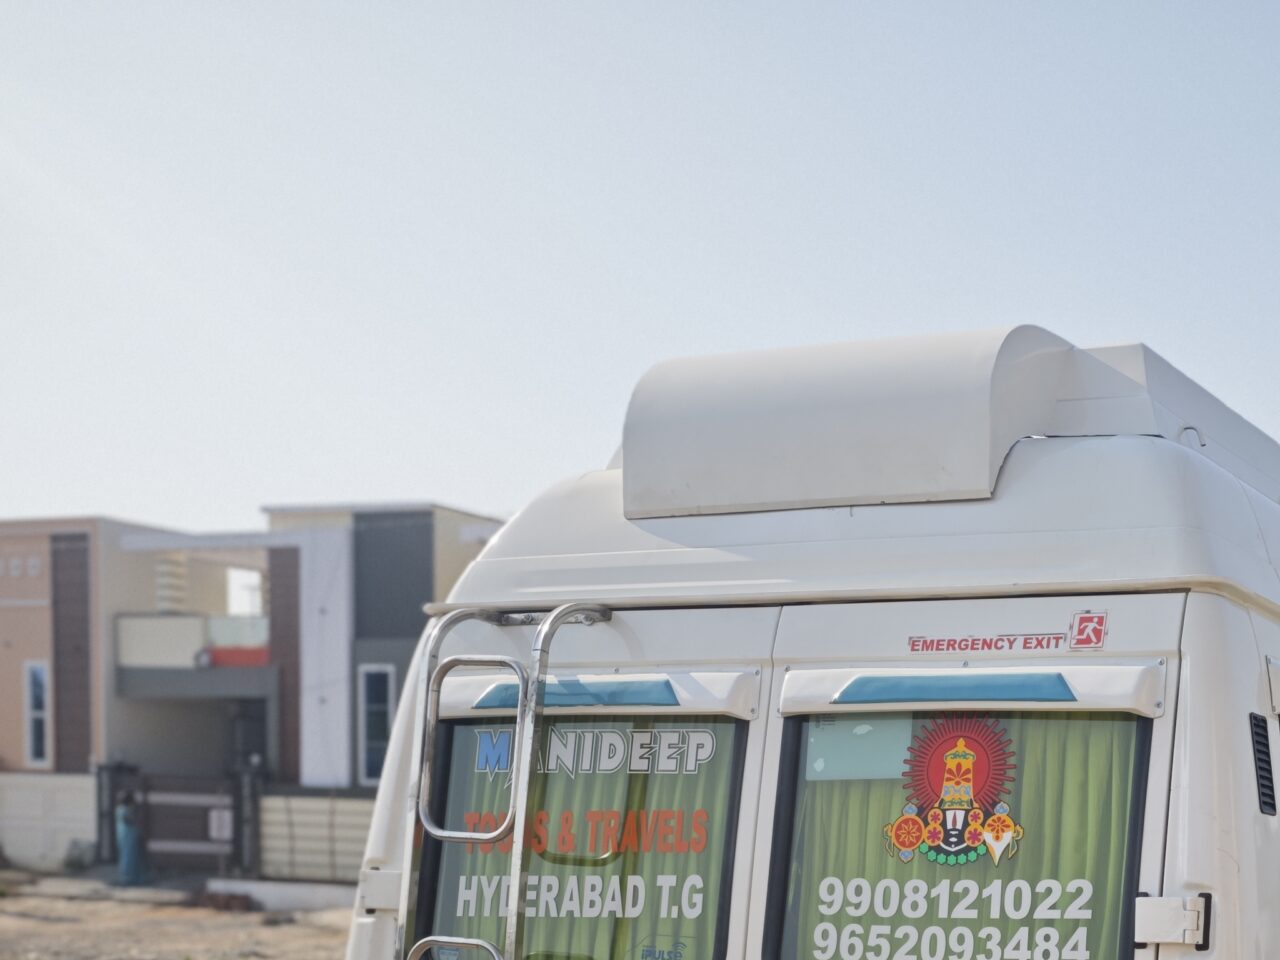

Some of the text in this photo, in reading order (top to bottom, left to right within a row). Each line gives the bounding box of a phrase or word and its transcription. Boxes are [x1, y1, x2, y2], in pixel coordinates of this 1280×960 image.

[911, 636, 1064, 652] EMERGENCY EXIT
[464, 809, 709, 854] TOS & TRAVELS
[656, 874, 704, 919] T.G
[818, 876, 1094, 920] 9908121022
